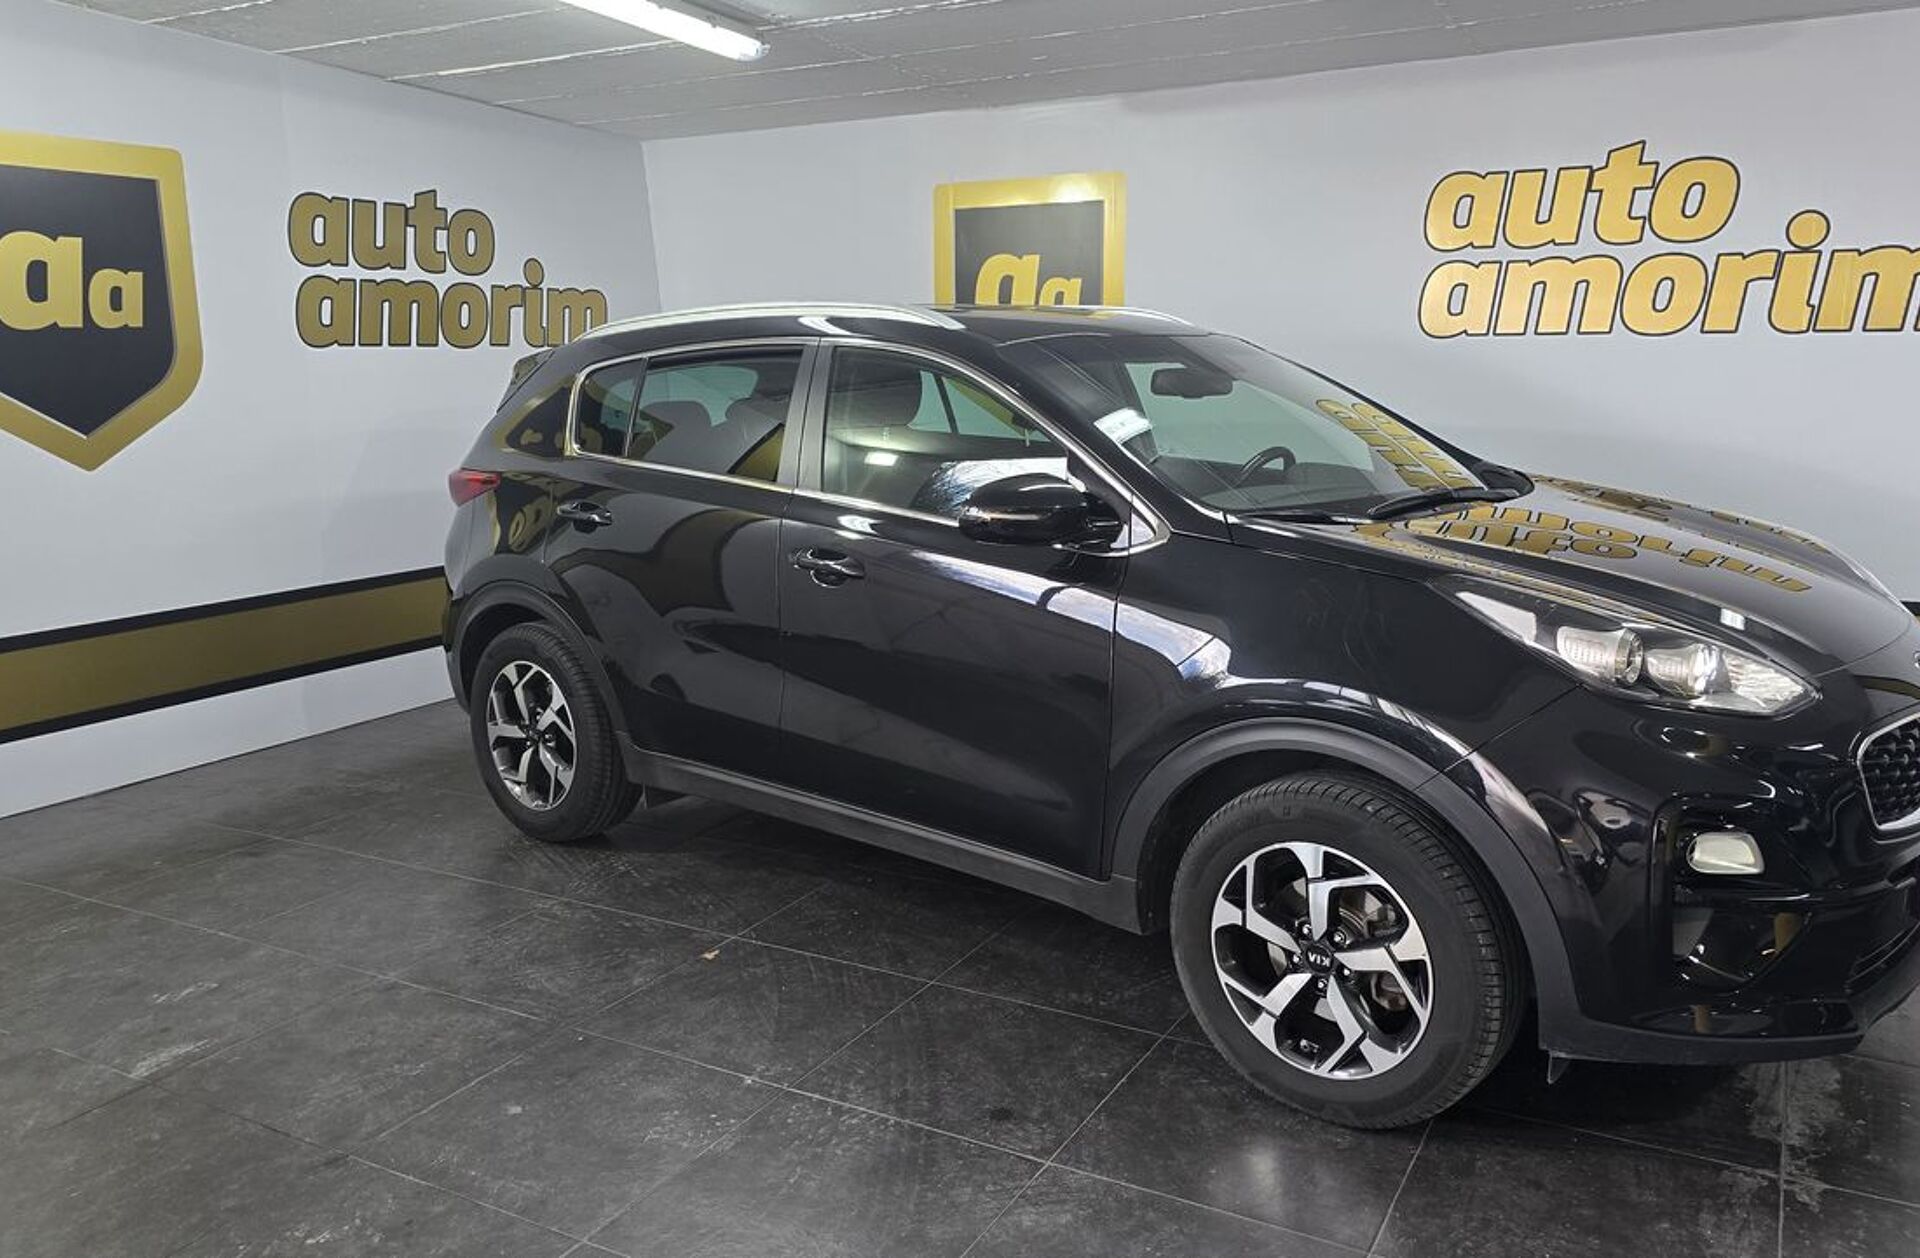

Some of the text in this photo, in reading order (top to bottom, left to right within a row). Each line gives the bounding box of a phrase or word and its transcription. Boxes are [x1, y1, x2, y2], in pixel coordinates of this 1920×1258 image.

[288, 190, 495, 275] auto
[1424, 140, 1740, 251] auto
[295, 258, 607, 348] amorim
[1418, 209, 1920, 338] amorim
[1307, 950, 1331, 968] KIA
